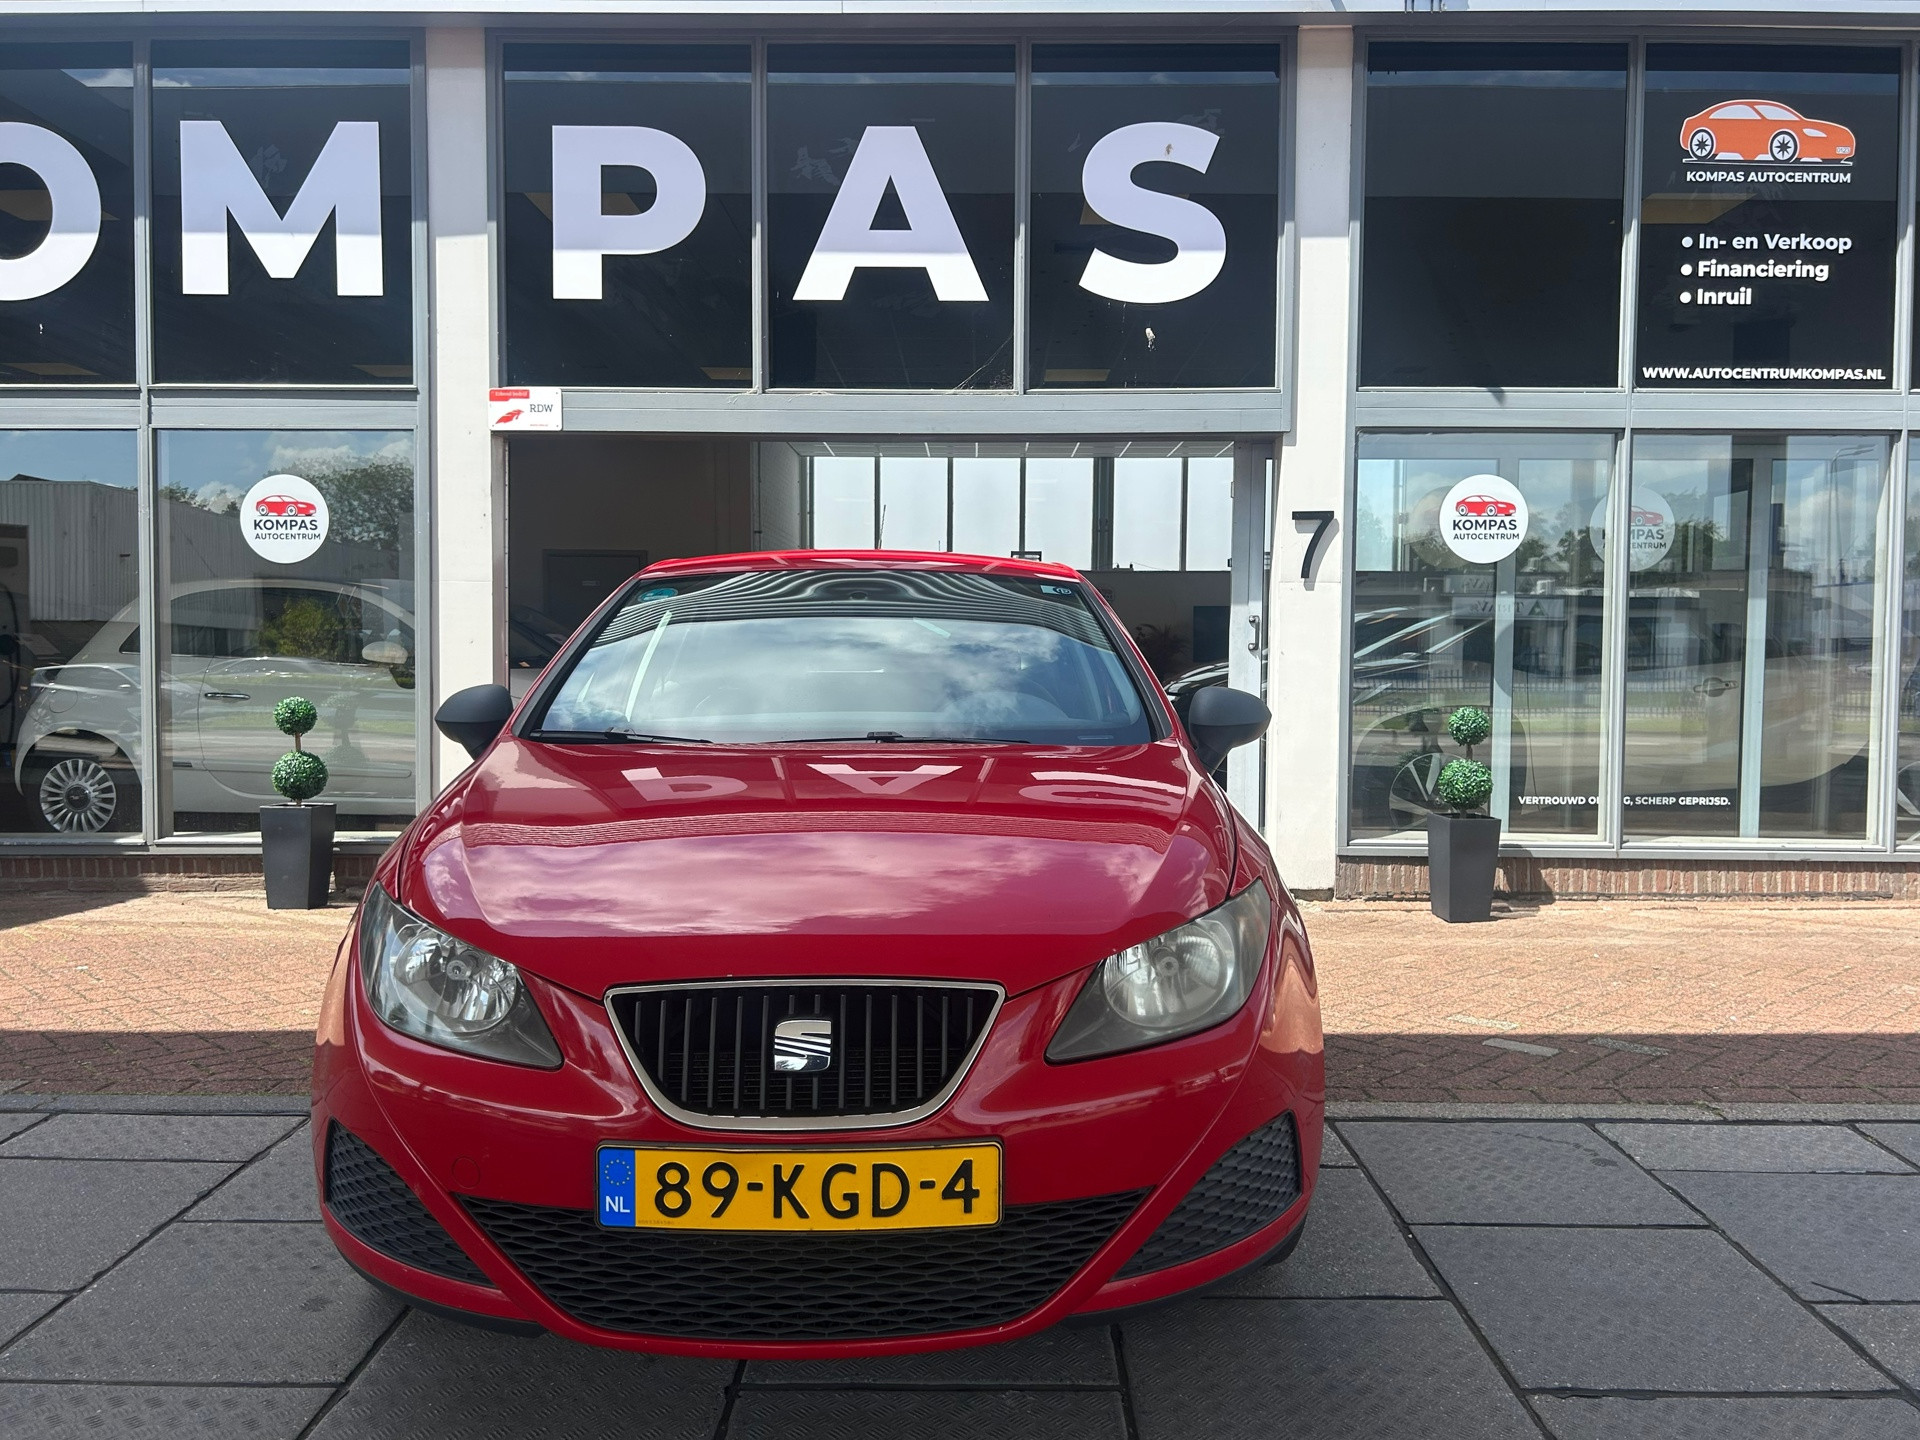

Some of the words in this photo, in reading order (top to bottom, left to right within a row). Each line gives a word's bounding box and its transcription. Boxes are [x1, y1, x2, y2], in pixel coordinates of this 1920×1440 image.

[1686, 171, 1744, 182] KOMPAS
[1748, 172, 1851, 184] AUTOCENTRUM
[1699, 233, 1726, 249] In-
[1732, 235, 1758, 249] en
[1764, 233, 1852, 254] Verkoop
[1697, 259, 1829, 282] Financiering
[1697, 287, 1751, 305] Inruil
[1642, 367, 1886, 380] WWW.AUTOCENTRUMKOMPAS.NL
[529, 404, 553, 413] RDW
[253, 519, 318, 531] KOMPAS
[1452, 519, 1518, 531] KOMPAS
[254, 532, 321, 540] AUTOCENTRUM
[1453, 532, 1520, 541] AUTOCENTRUM
[1292, 510, 1335, 579] 7
[1518, 796, 1586, 805] VERTROUWD
[1635, 796, 1676, 805] SCHERP
[1678, 796, 1731, 806] GEPRIJSD.
[605, 1196, 631, 1214] NL
[654, 1158, 981, 1219] 89-KGD-4
